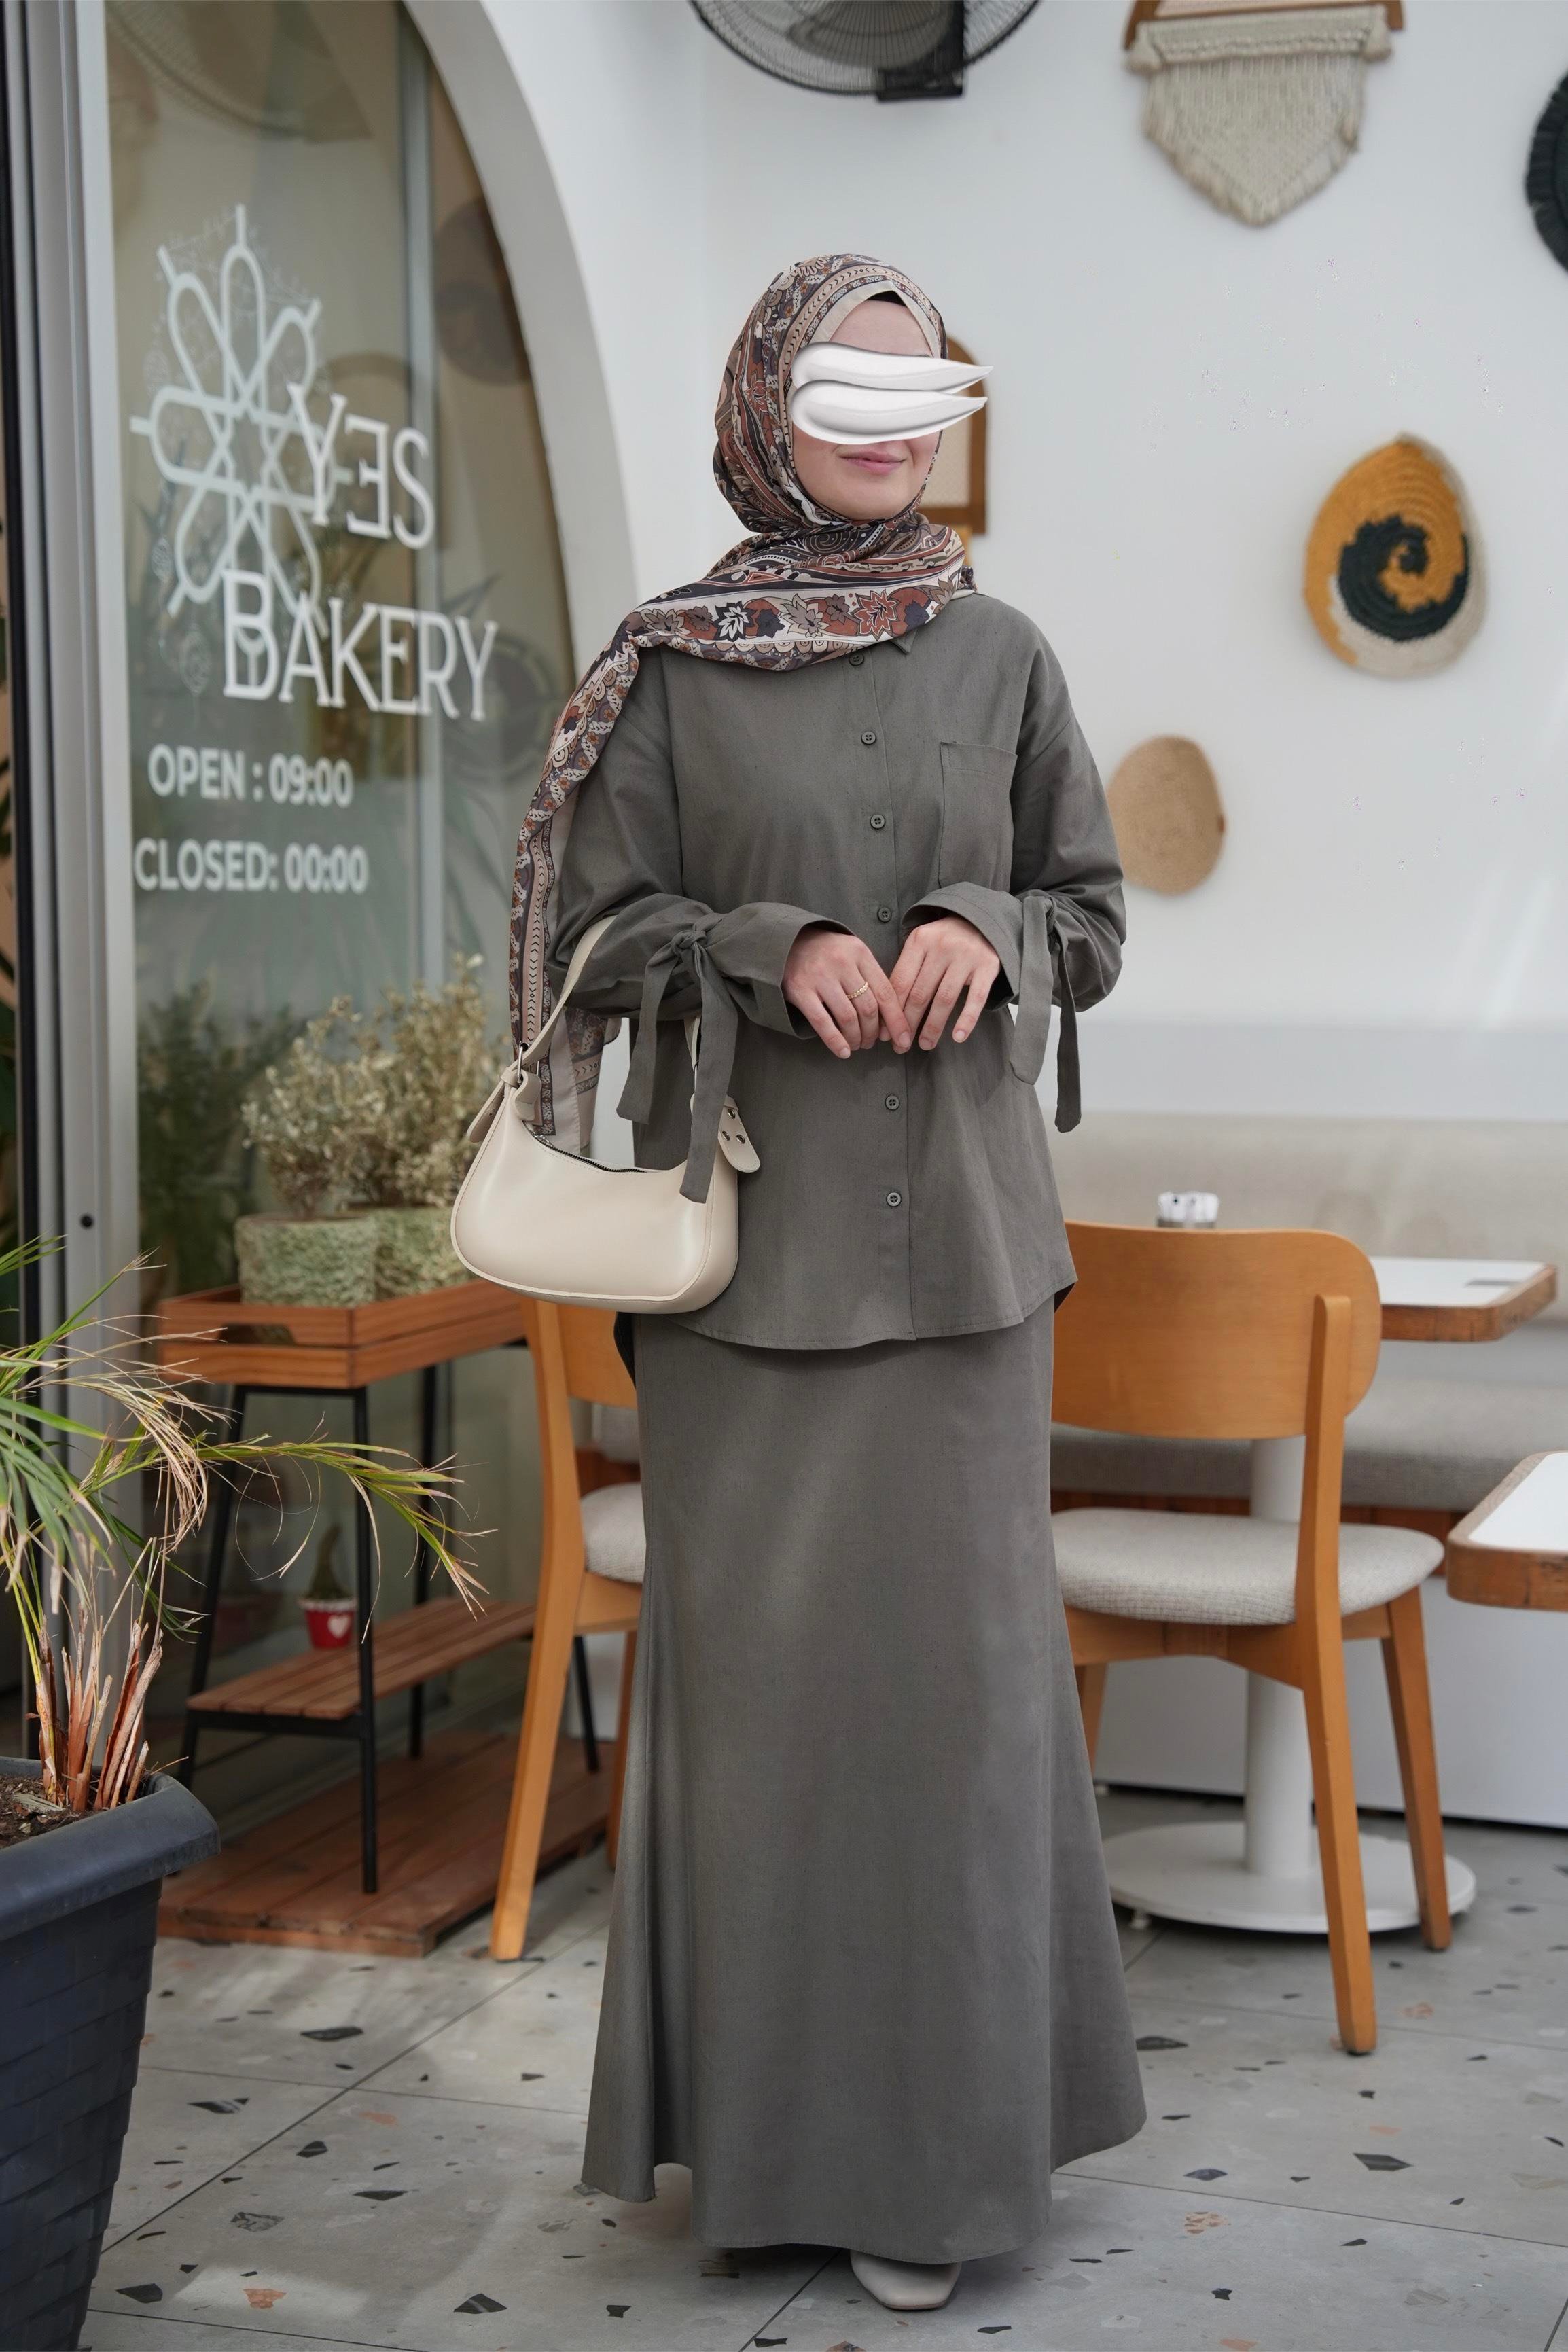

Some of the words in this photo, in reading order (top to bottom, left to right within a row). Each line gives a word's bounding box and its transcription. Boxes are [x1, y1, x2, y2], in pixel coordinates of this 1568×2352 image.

[223, 569, 499, 721] BAKERY
[268, 753, 353, 808] 09:00
[284, 842, 369, 895] 00:00
